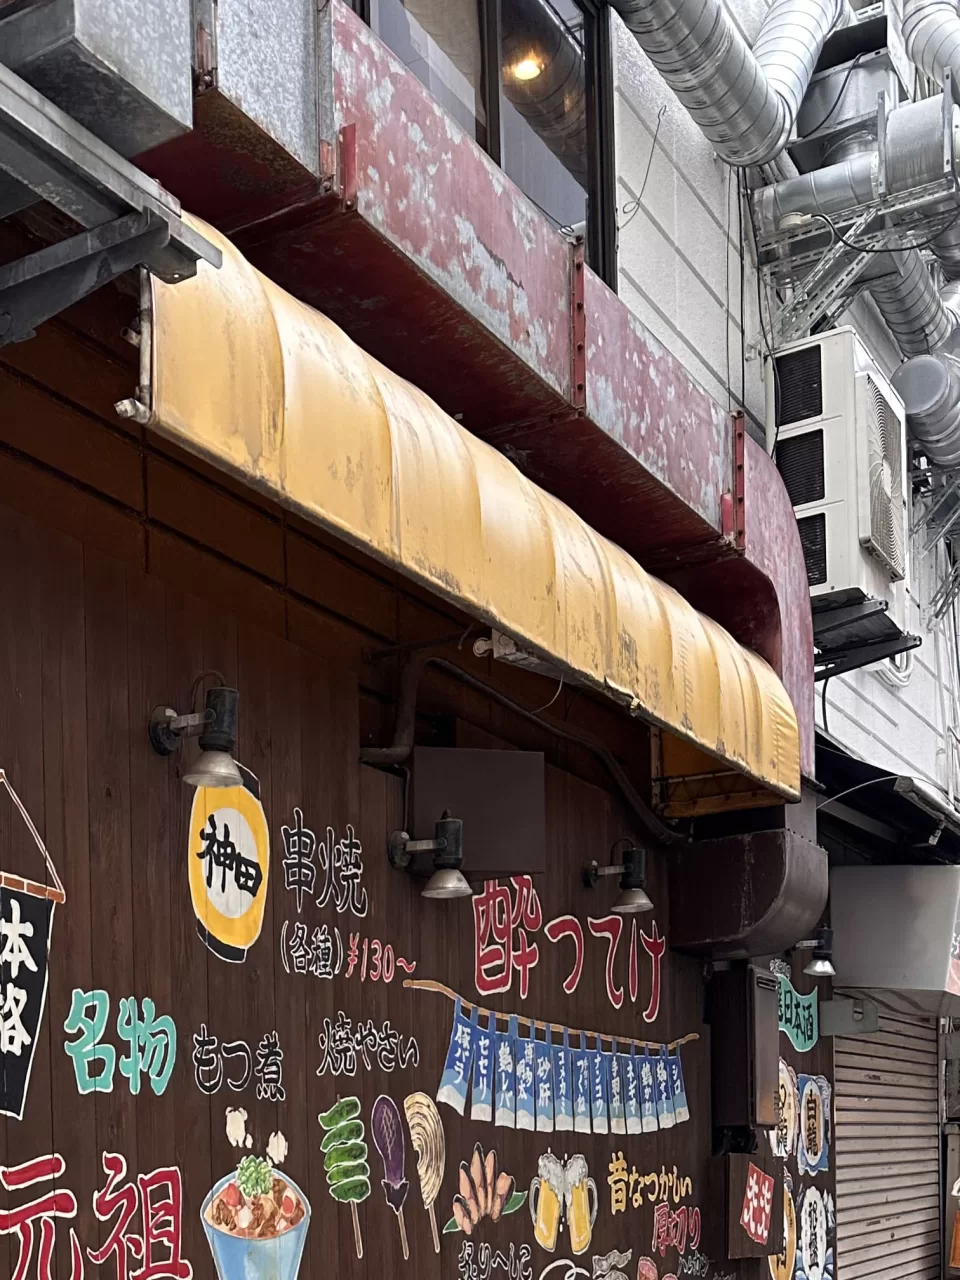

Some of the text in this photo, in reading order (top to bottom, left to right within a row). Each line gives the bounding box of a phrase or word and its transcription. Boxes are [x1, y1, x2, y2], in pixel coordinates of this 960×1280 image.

[198, 815, 263, 897] 神田
[280, 807, 368, 918] 串焼
[64, 988, 178, 1096] 名物
[193, 1023, 287, 1101] もつ煮
[316, 1011, 420, 1076] 焼やさい
[478, 1035, 489, 1100] セセリ
[607, 1151, 692, 1215] 昔なつかしい
